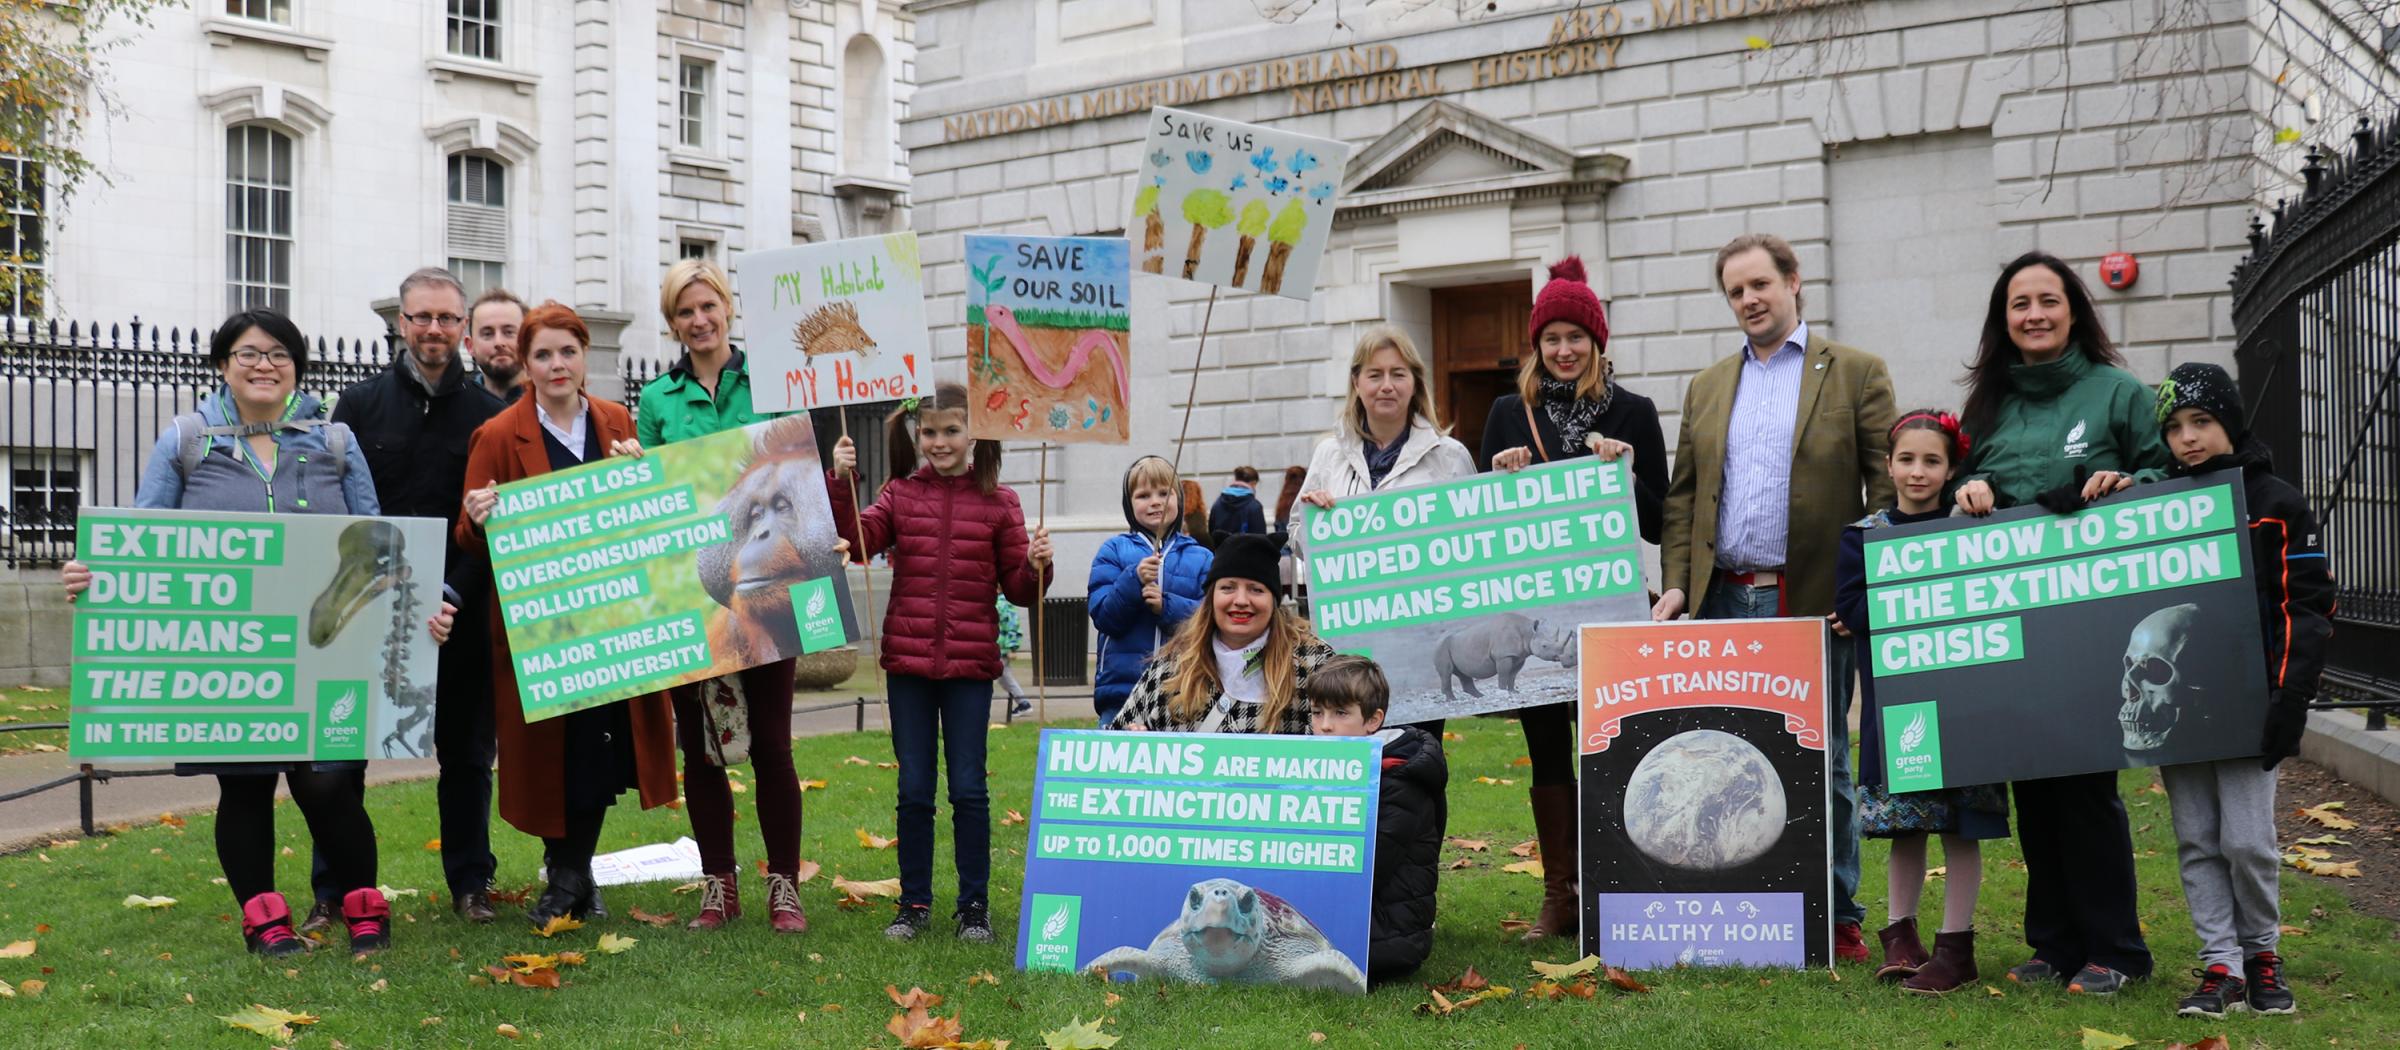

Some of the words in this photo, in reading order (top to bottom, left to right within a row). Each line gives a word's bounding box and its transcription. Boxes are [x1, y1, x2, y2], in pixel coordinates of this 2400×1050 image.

[1548, 6, 1623, 44] ARD
[943, 104, 1077, 140] NATIONAL
[1081, 73, 1209, 117] MUSEUM
[1217, 68, 1253, 96] OF
[1261, 43, 1398, 87] IRELAND
[1292, 66, 1446, 114] NATURAL
[1471, 37, 1624, 90] HISTORY
[1159, 115, 1214, 143] Save
[1016, 244, 1085, 272] SAVE
[773, 271, 801, 310] MY
[821, 255, 884, 297] Habitat
[1013, 278, 1060, 301] OUR
[1069, 282, 1125, 308] SOIL
[786, 367, 817, 408] MY
[835, 352, 918, 401] Home!
[490, 479, 590, 519] HABITAT
[592, 463, 653, 495] LOSS
[1311, 502, 1386, 541] 60%
[1392, 493, 1438, 528] OF
[1446, 464, 1621, 517] WILDLIFE
[90, 524, 273, 560] EXTINCT
[494, 513, 594, 555] CLIMATE
[596, 491, 690, 530] CHANGE
[1876, 537, 1948, 577] ACT
[1957, 523, 2045, 567] NOW
[2054, 513, 2106, 550] TO
[2114, 495, 2215, 540] STOP
[501, 520, 727, 592] OVERCONSUMPTION
[1315, 543, 1421, 584] WIPED
[1428, 531, 1496, 567] OUT
[1504, 518, 1573, 556] DUE
[1579, 510, 1626, 542] TO
[90, 571, 172, 605] DUE
[183, 574, 238, 606] TO
[508, 575, 640, 625] POLLUTION
[1320, 587, 1454, 630] HUMANS
[1460, 570, 1554, 609] SINCE
[1561, 559, 1634, 594] 1970
[1877, 583, 1955, 624] THE
[1965, 541, 2221, 614] EXTINCTION
[87, 619, 264, 652] HUMANS
[804, 617, 834, 633] green
[522, 641, 597, 677] MAJOR
[599, 617, 697, 657] THREATS
[1663, 640, 1711, 659] FOR
[1722, 639, 1739, 657] A
[1881, 623, 2010, 672] CRISIS
[88, 671, 165, 700] THE
[172, 670, 283, 699] DODO
[527, 682, 558, 702] TO
[562, 643, 706, 695] BIODIVERSITY
[1593, 677, 1651, 709] JUST
[1657, 670, 1810, 702] TRANSITION
[85, 723, 112, 743] IN
[119, 723, 169, 742] THE
[175, 723, 243, 743] DEAD
[249, 722, 300, 743] ZOO
[323, 727, 358, 738] green
[1049, 740, 1206, 776] HUMANS
[1213, 756, 1261, 777] ARE
[1266, 757, 1363, 781] MAKING
[1895, 754, 1932, 769] green
[1047, 792, 1078, 809] THE
[1081, 787, 1276, 821] EXTINCTION
[1279, 794, 1362, 825] RATE
[1043, 834, 1070, 853] UP
[1076, 835, 1101, 854] TO
[1107, 834, 1171, 858] 1,000
[1177, 836, 1254, 862] TIMES
[1260, 840, 1356, 867] HIGHER
[1675, 900, 1702, 916] TO
[1711, 899, 1725, 915] A
[1036, 944, 1068, 955] green
[1611, 924, 1713, 942] HEALTHY
[1725, 923, 1794, 941] HOME
